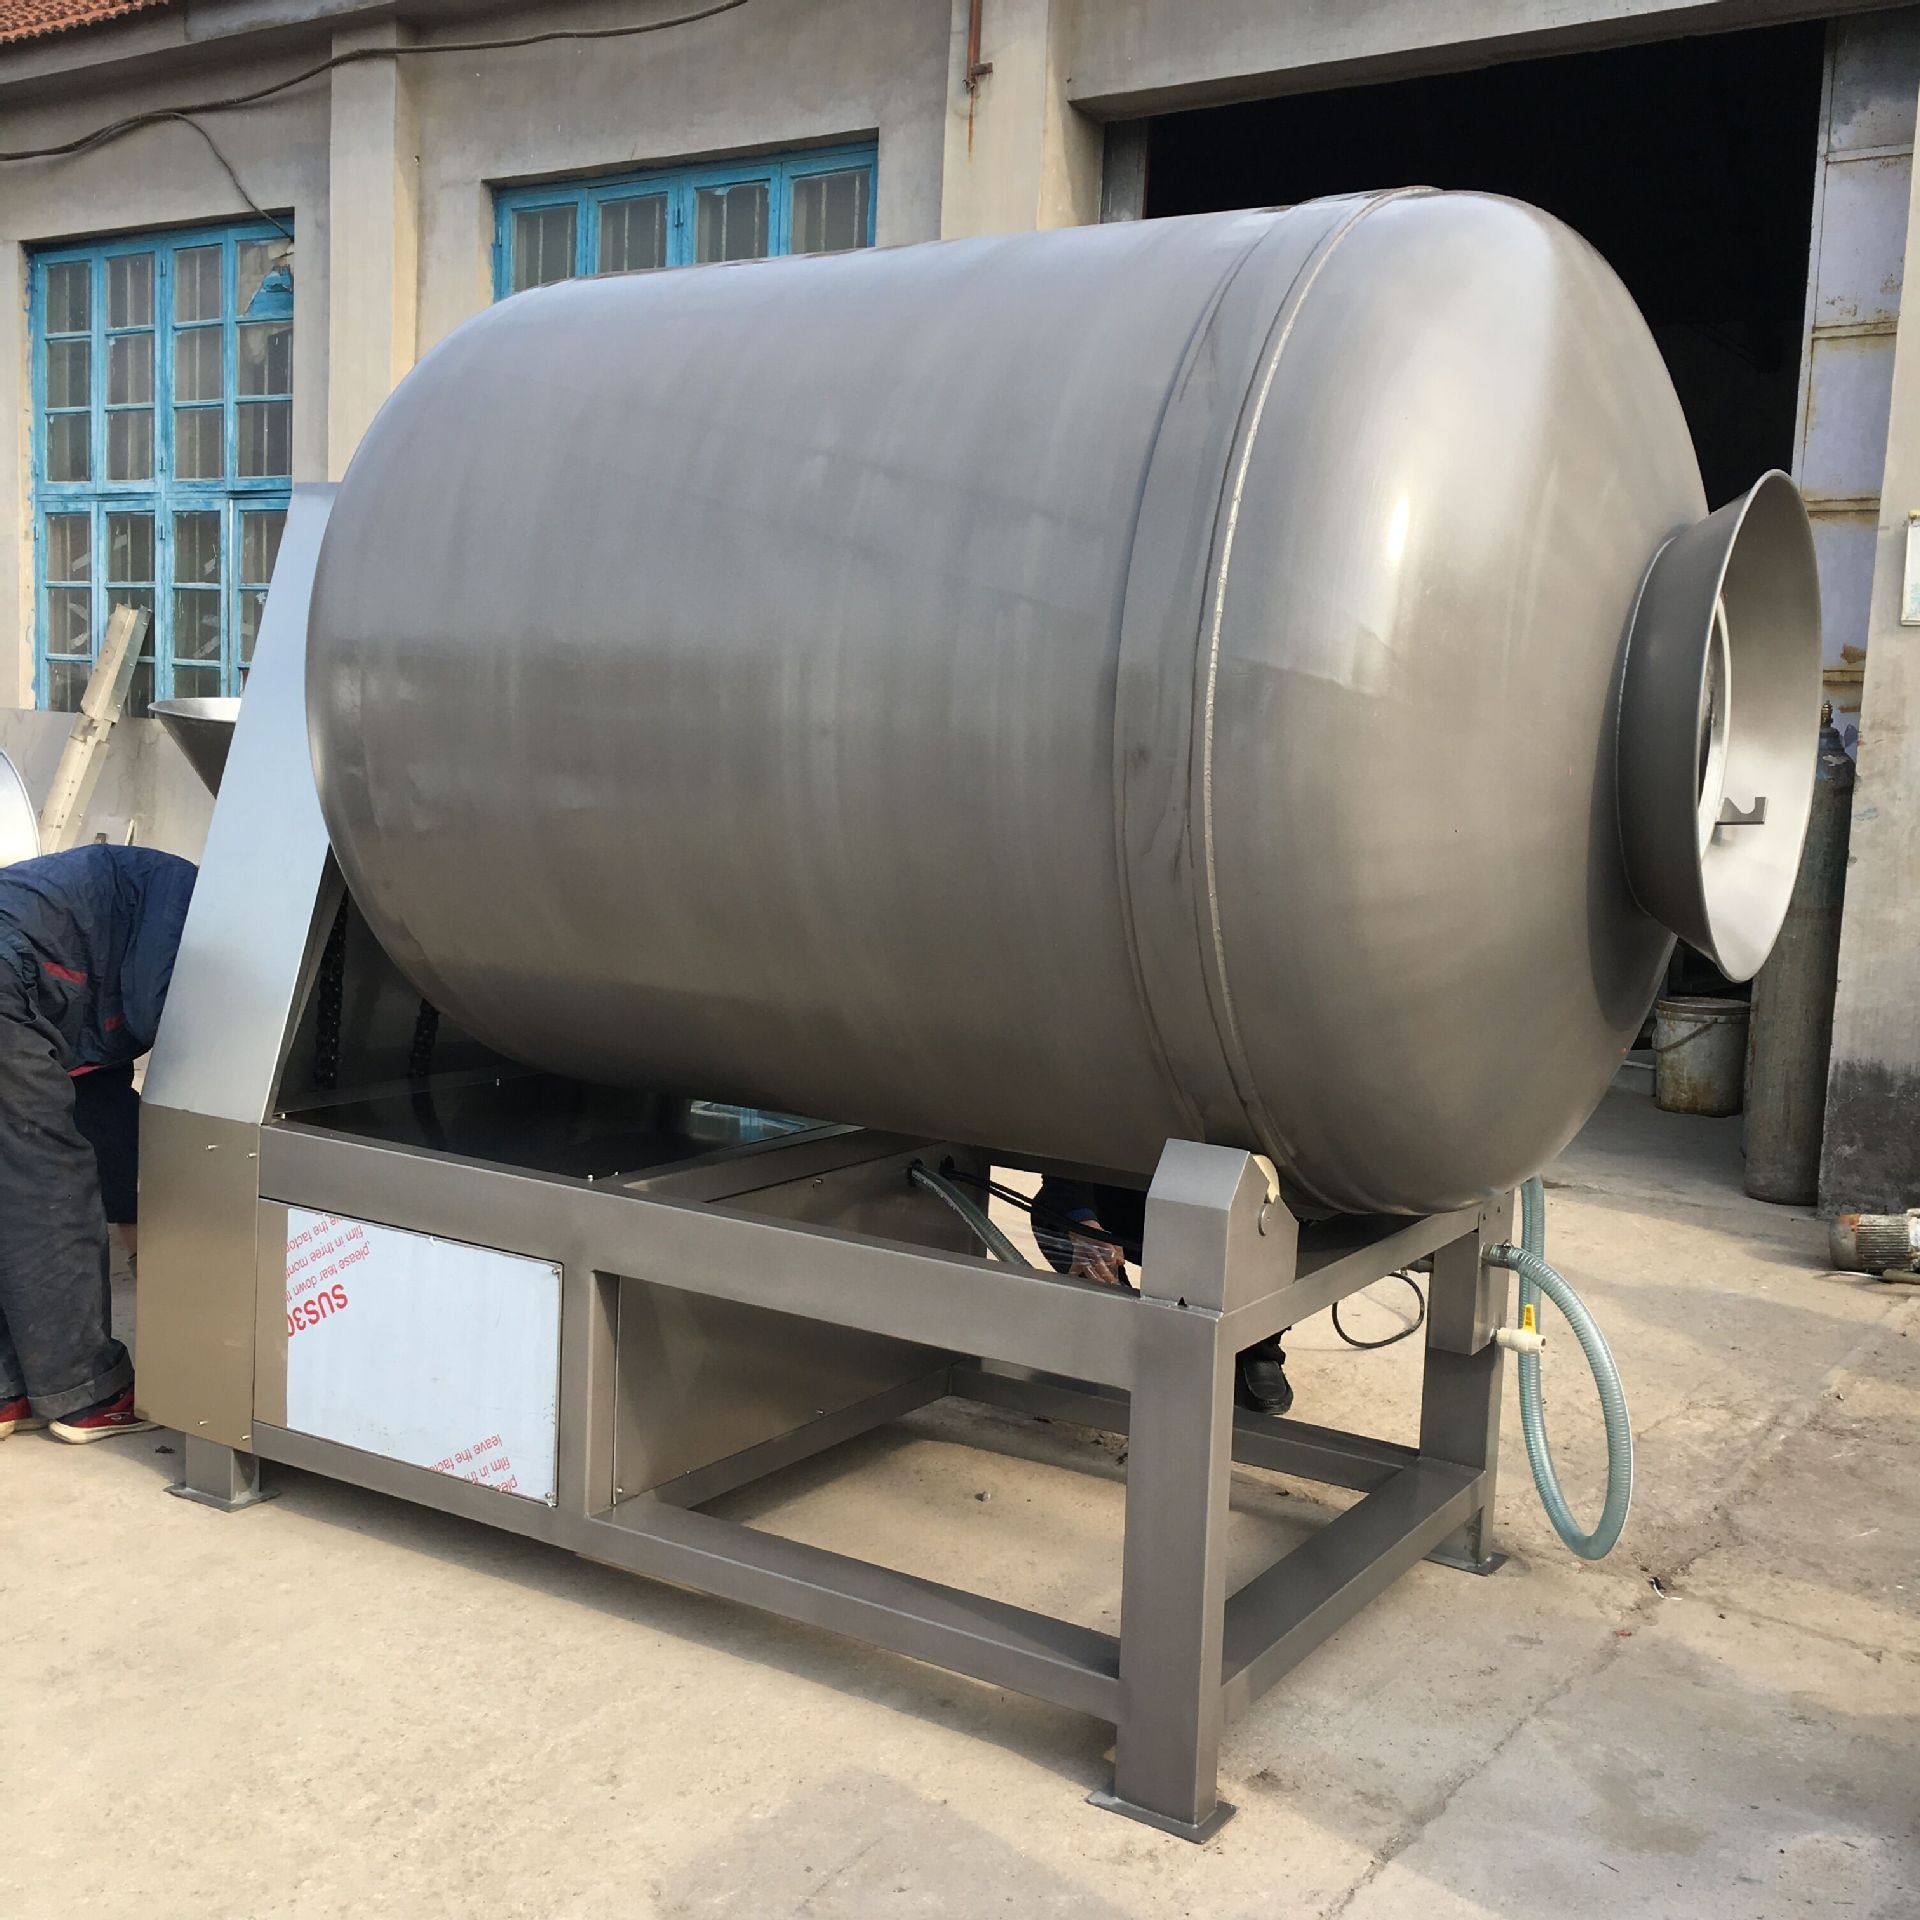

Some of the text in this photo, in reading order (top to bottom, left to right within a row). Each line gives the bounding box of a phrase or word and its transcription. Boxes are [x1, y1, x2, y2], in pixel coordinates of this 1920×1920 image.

[313, 1221, 329, 1236] the
[346, 1225, 364, 1241] film
[335, 1236, 345, 1247] in
[309, 1242, 335, 1261] three
[339, 1241, 370, 1269] please
[320, 1264, 338, 1281] tear
[293, 1276, 317, 1296] down
[473, 1434, 503, 1454] leave
[455, 1448, 472, 1463] the
[479, 1465, 490, 1478] in
[490, 1456, 511, 1472] film
